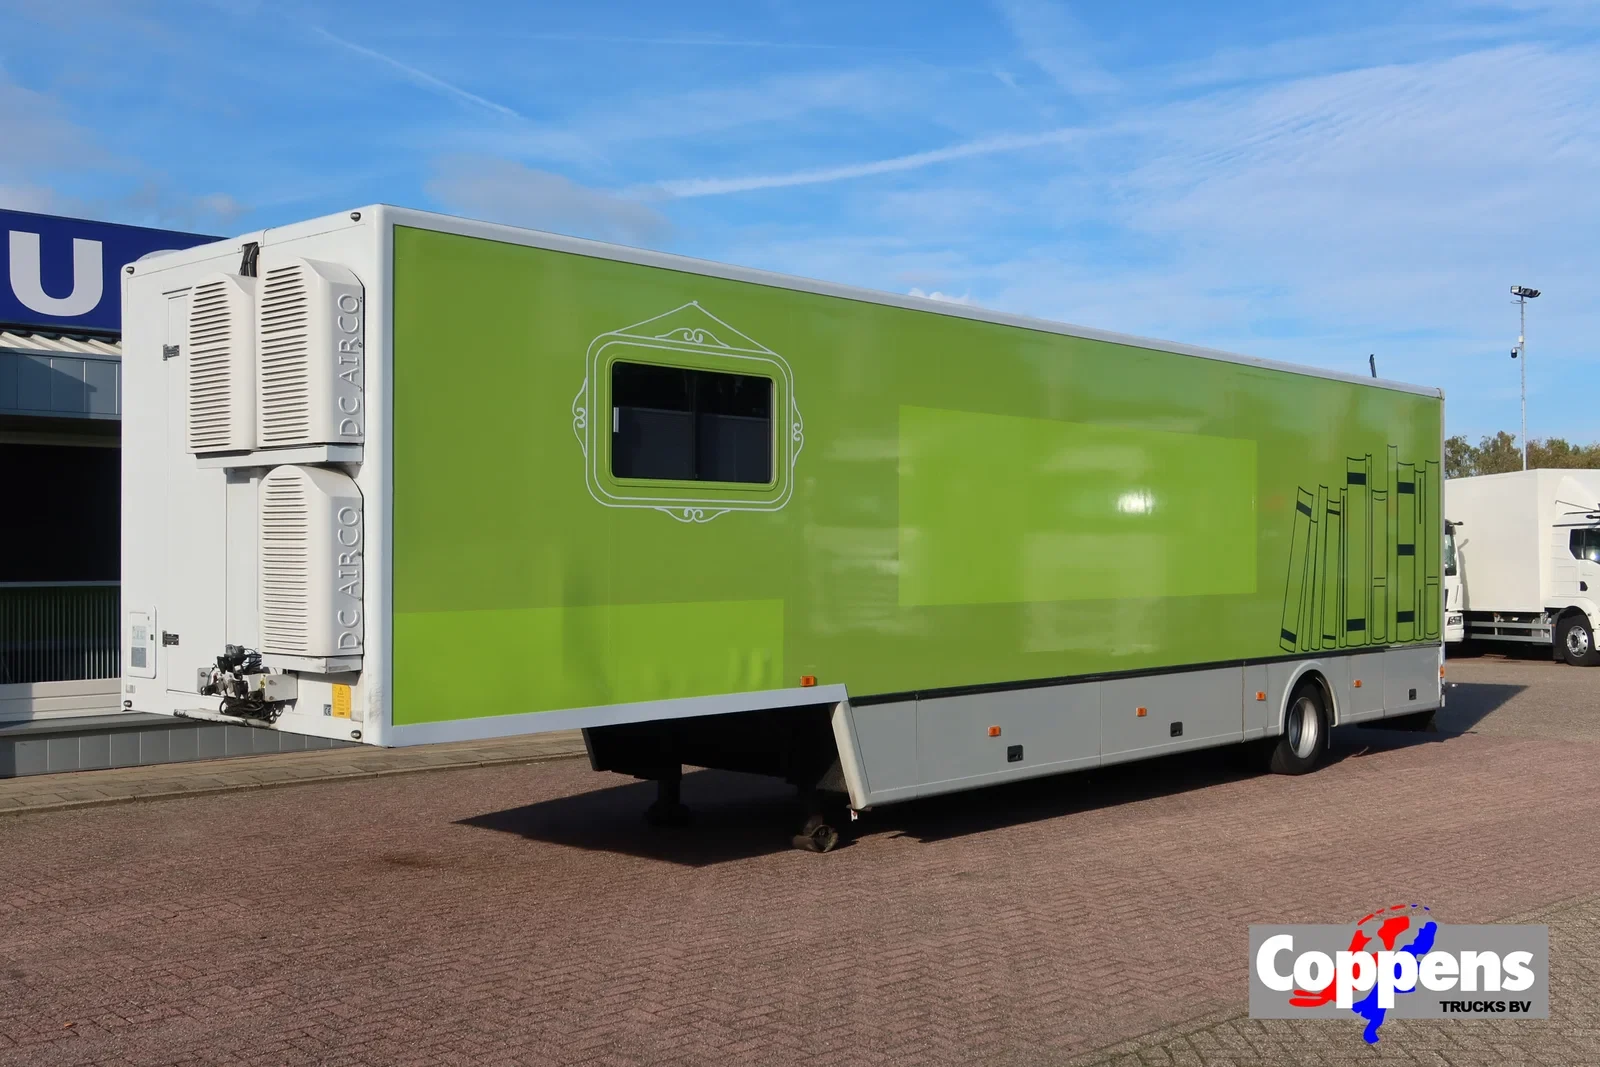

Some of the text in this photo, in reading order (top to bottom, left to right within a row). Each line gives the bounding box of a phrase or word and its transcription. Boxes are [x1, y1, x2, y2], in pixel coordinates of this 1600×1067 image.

[339, 293, 362, 437] DC AIRCO
[338, 507, 361, 650] DC AIRCO
